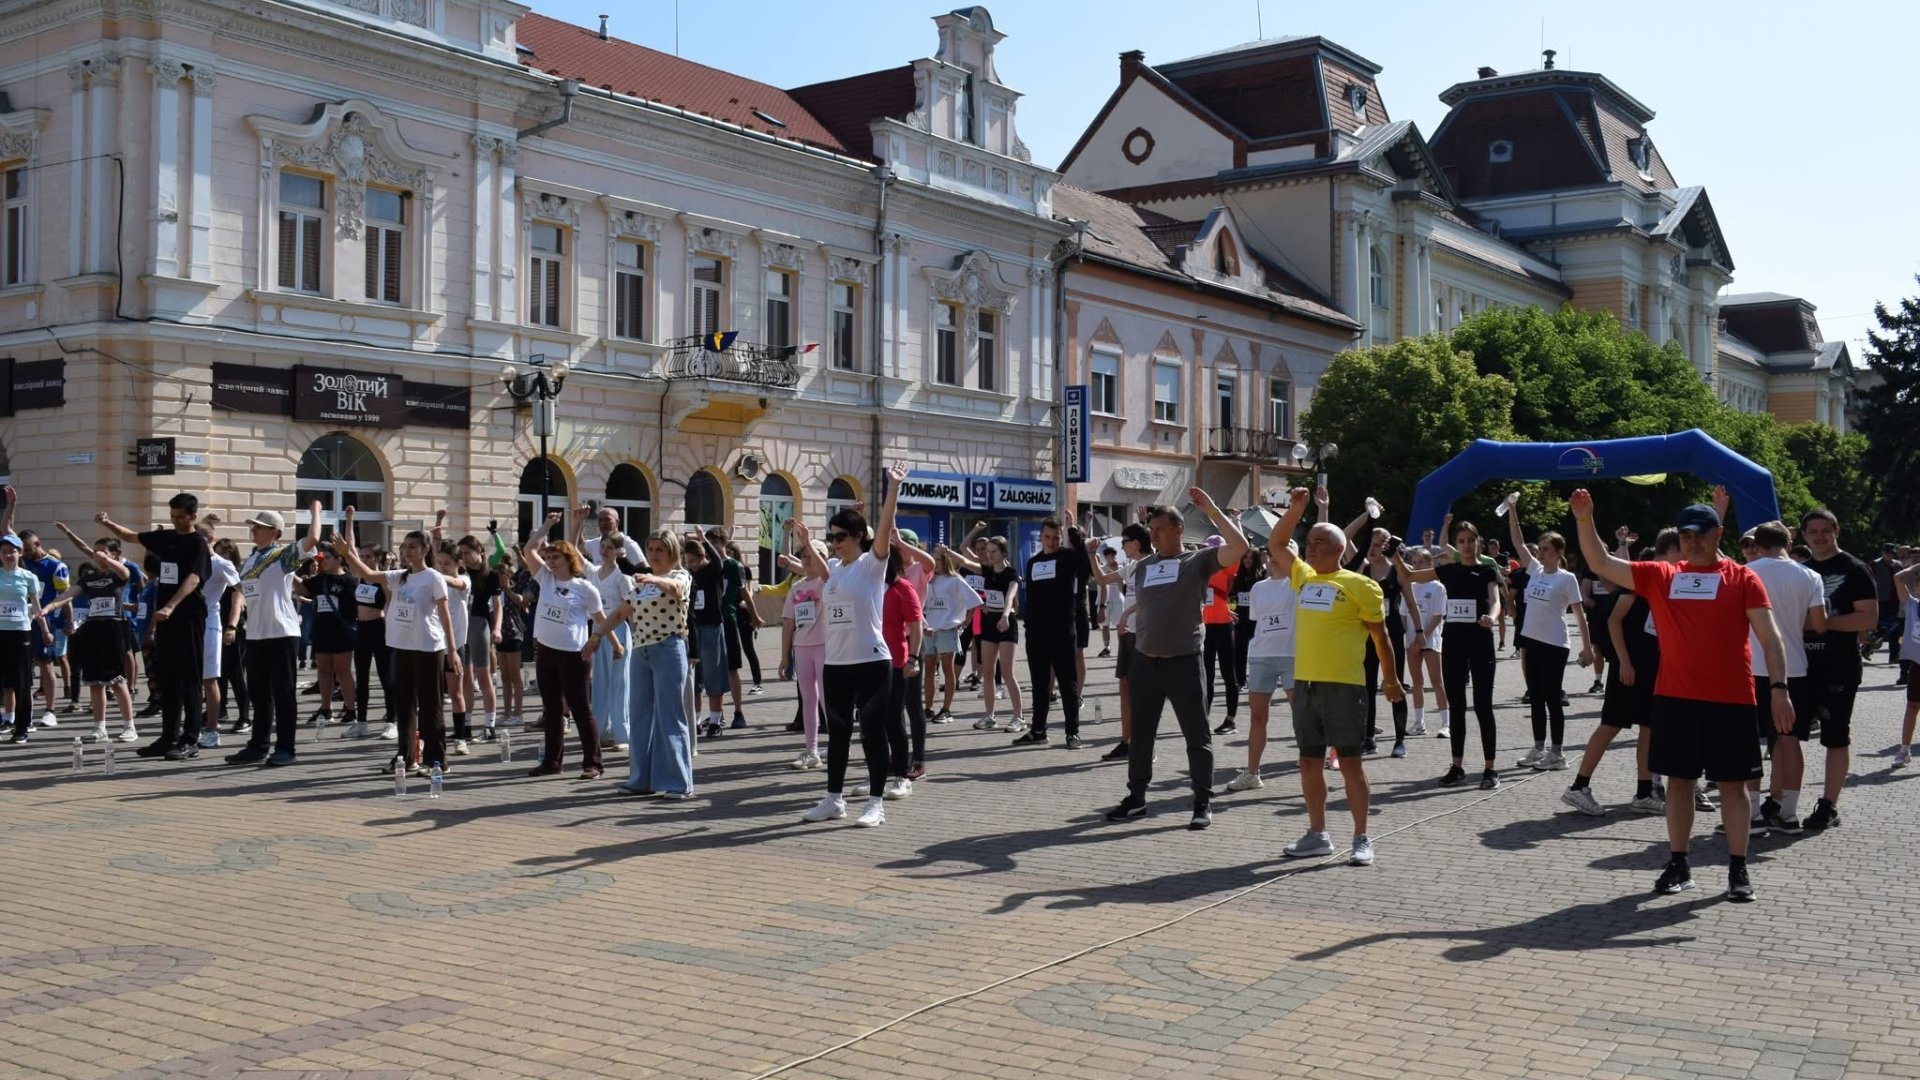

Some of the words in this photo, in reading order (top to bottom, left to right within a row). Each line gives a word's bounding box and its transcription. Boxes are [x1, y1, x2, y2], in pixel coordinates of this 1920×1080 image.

[337, 391, 367, 412] ВІК
[1070, 409, 1078, 475] ЛОМБАРД
[900, 482, 959, 502] ЛОМБАРД
[1000, 486, 1051, 505] ZÁLOGHÁZ
[1158, 565, 1164, 573] 2
[1692, 578, 1702, 588] 5
[1315, 588, 1322, 598] 4
[833, 608, 843, 618] 23
[1453, 605, 1469, 614] 214
[1269, 616, 1280, 626] 24
